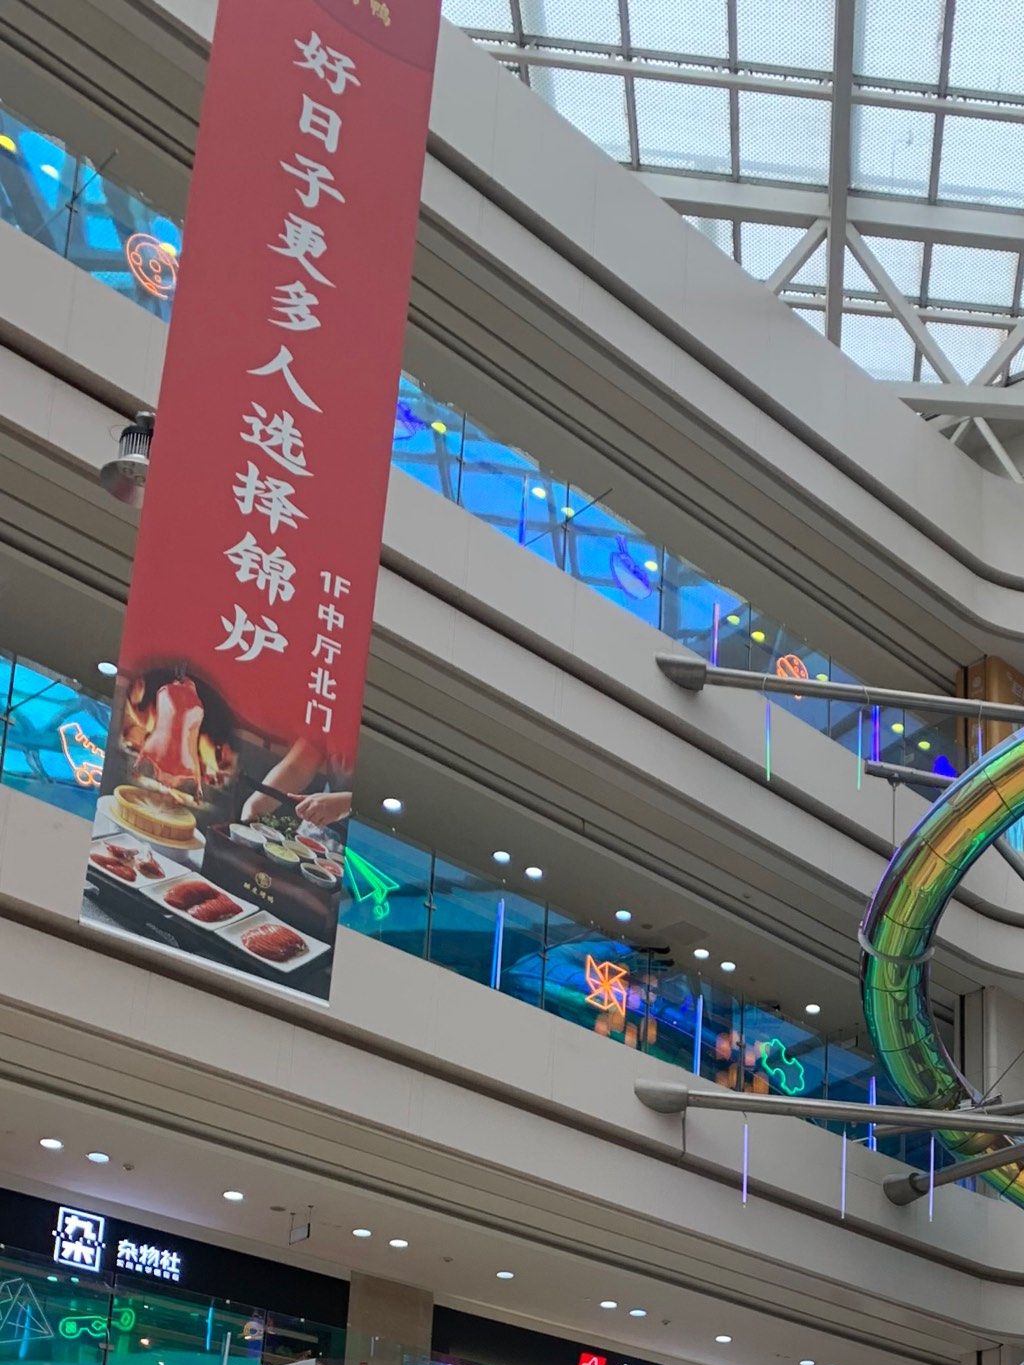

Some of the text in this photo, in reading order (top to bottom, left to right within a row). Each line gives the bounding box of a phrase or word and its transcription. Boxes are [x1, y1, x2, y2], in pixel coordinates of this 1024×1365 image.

[214, 31, 361, 662] 好日子更多人选择锦炉
[304, 571, 351, 732] 1F中厅北门
[117, 1239, 180, 1274] 杂物社
